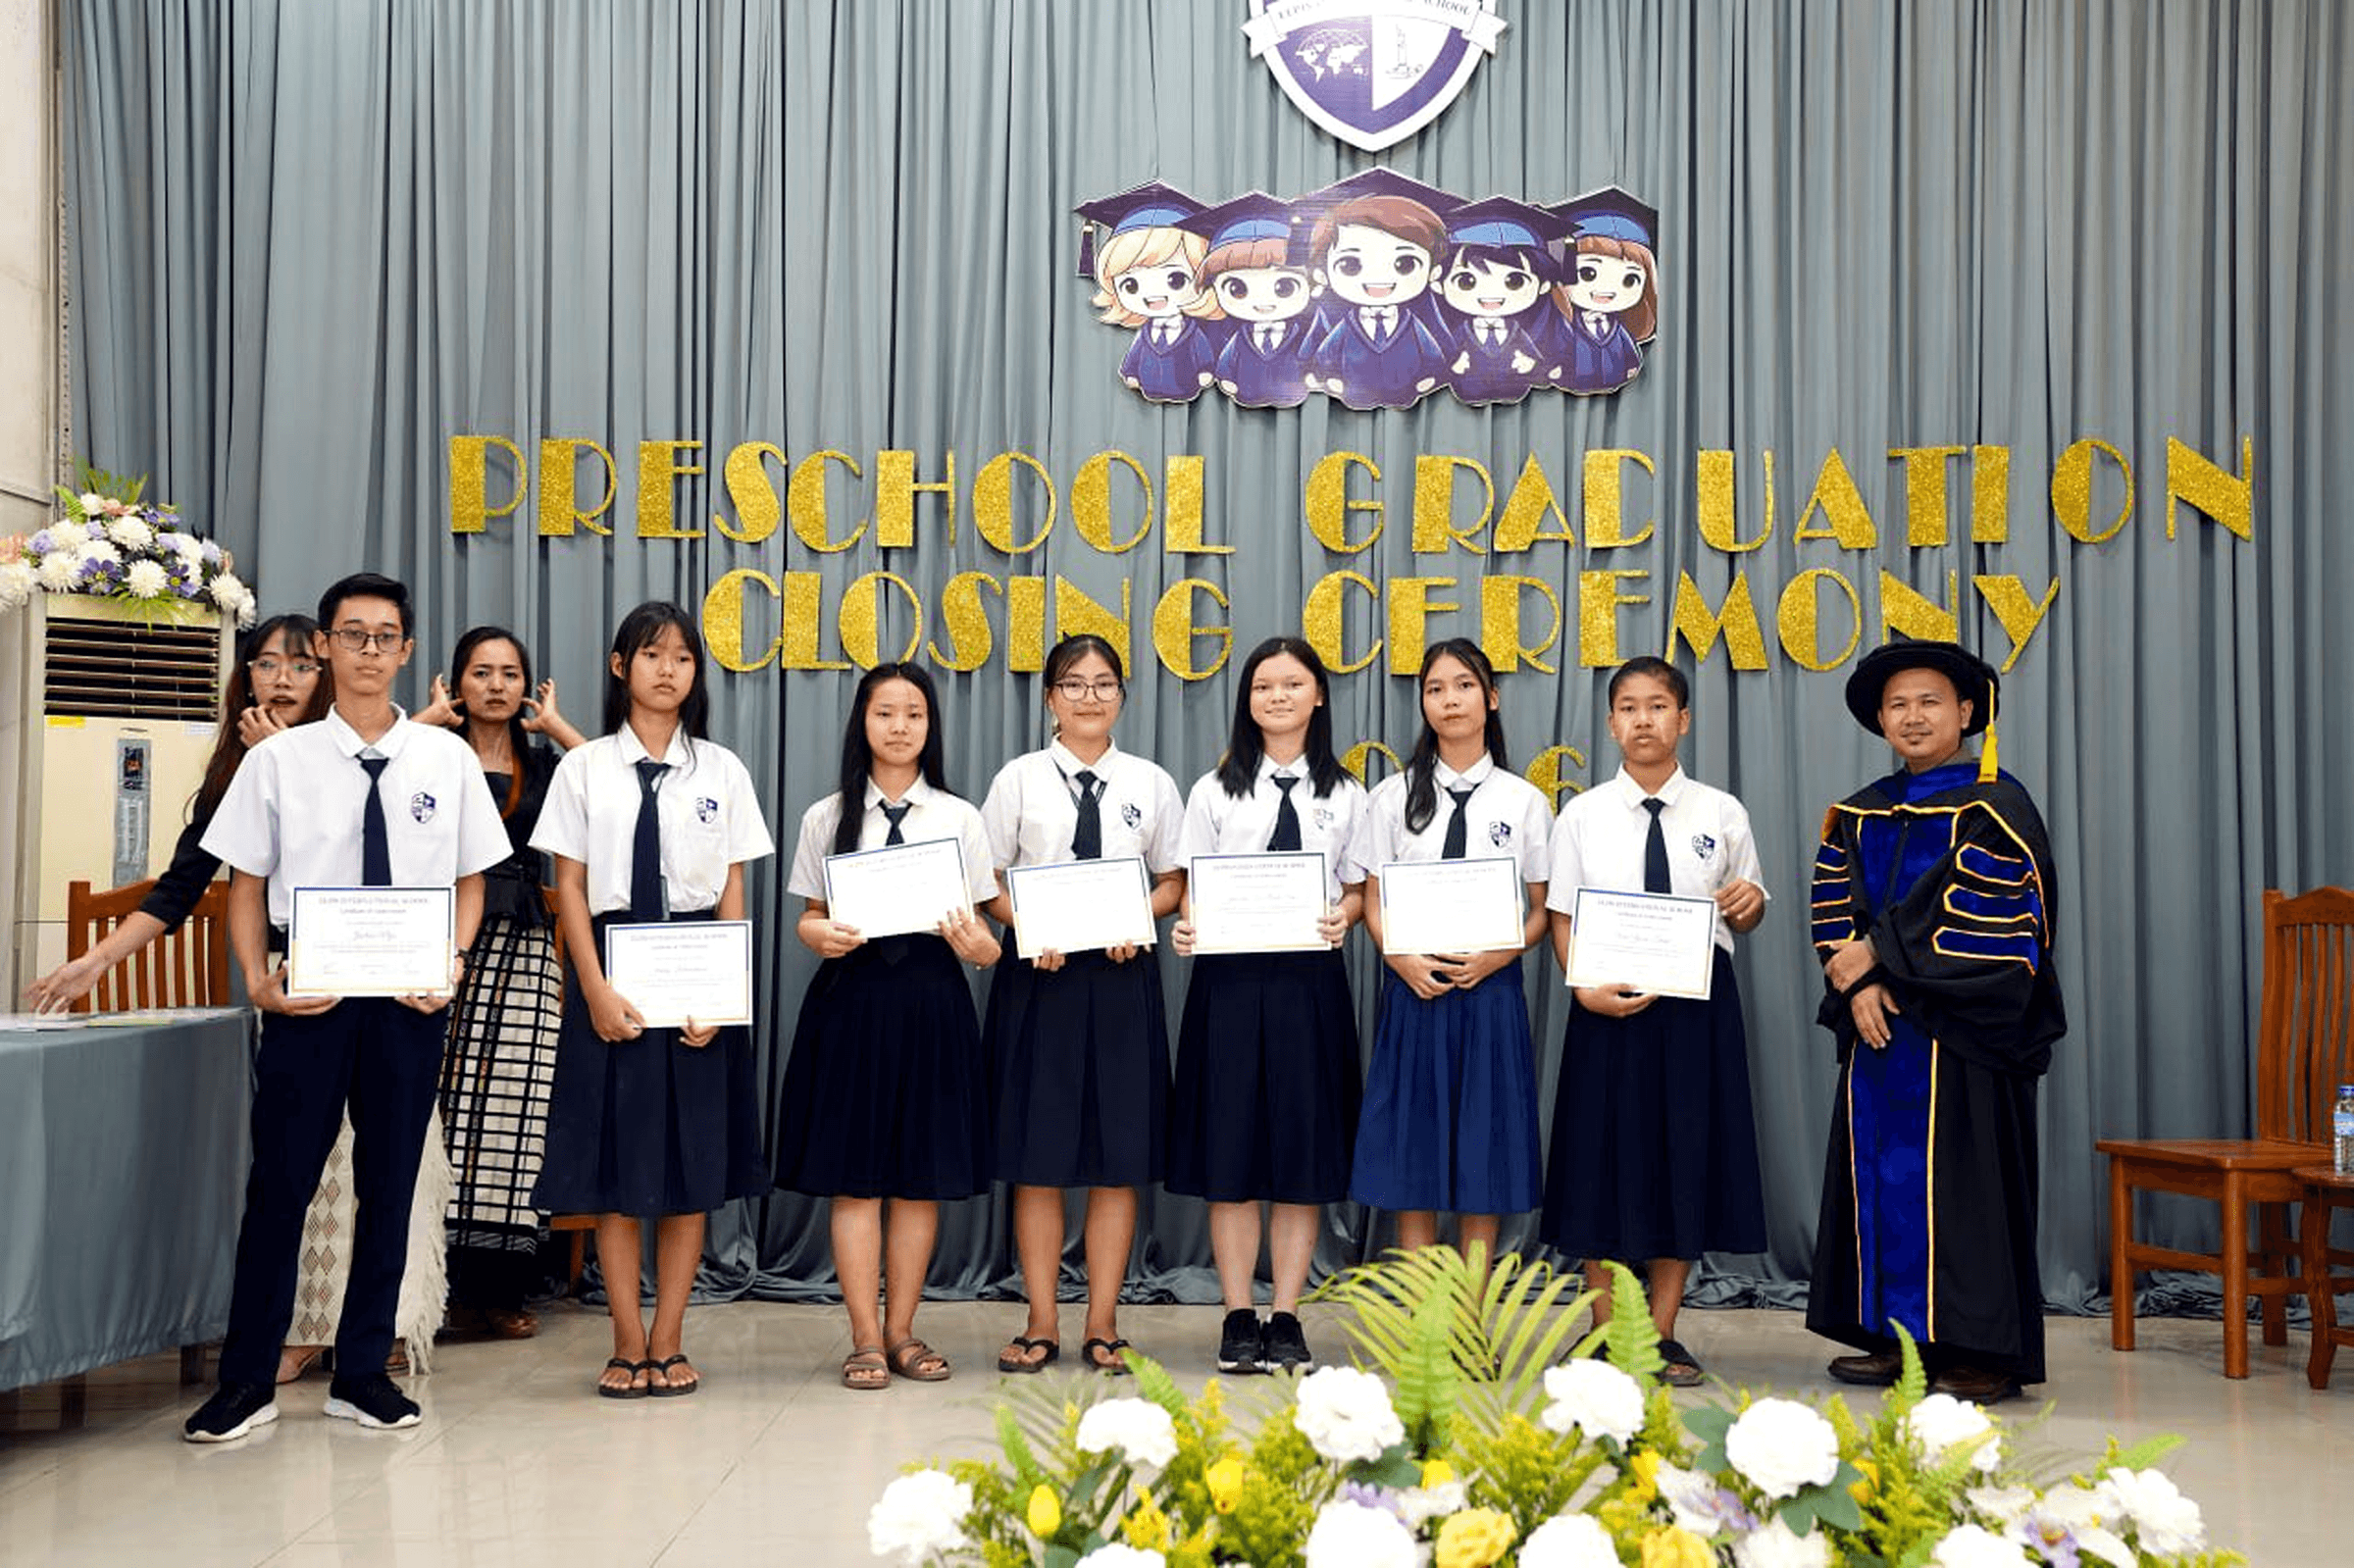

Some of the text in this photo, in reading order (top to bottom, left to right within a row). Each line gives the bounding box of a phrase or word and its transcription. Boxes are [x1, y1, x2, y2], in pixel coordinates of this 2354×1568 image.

[449, 436, 2255, 556] PRESCHOOL GRADUATION
[702, 568, 2062, 681] CLOSING CEREMONY
